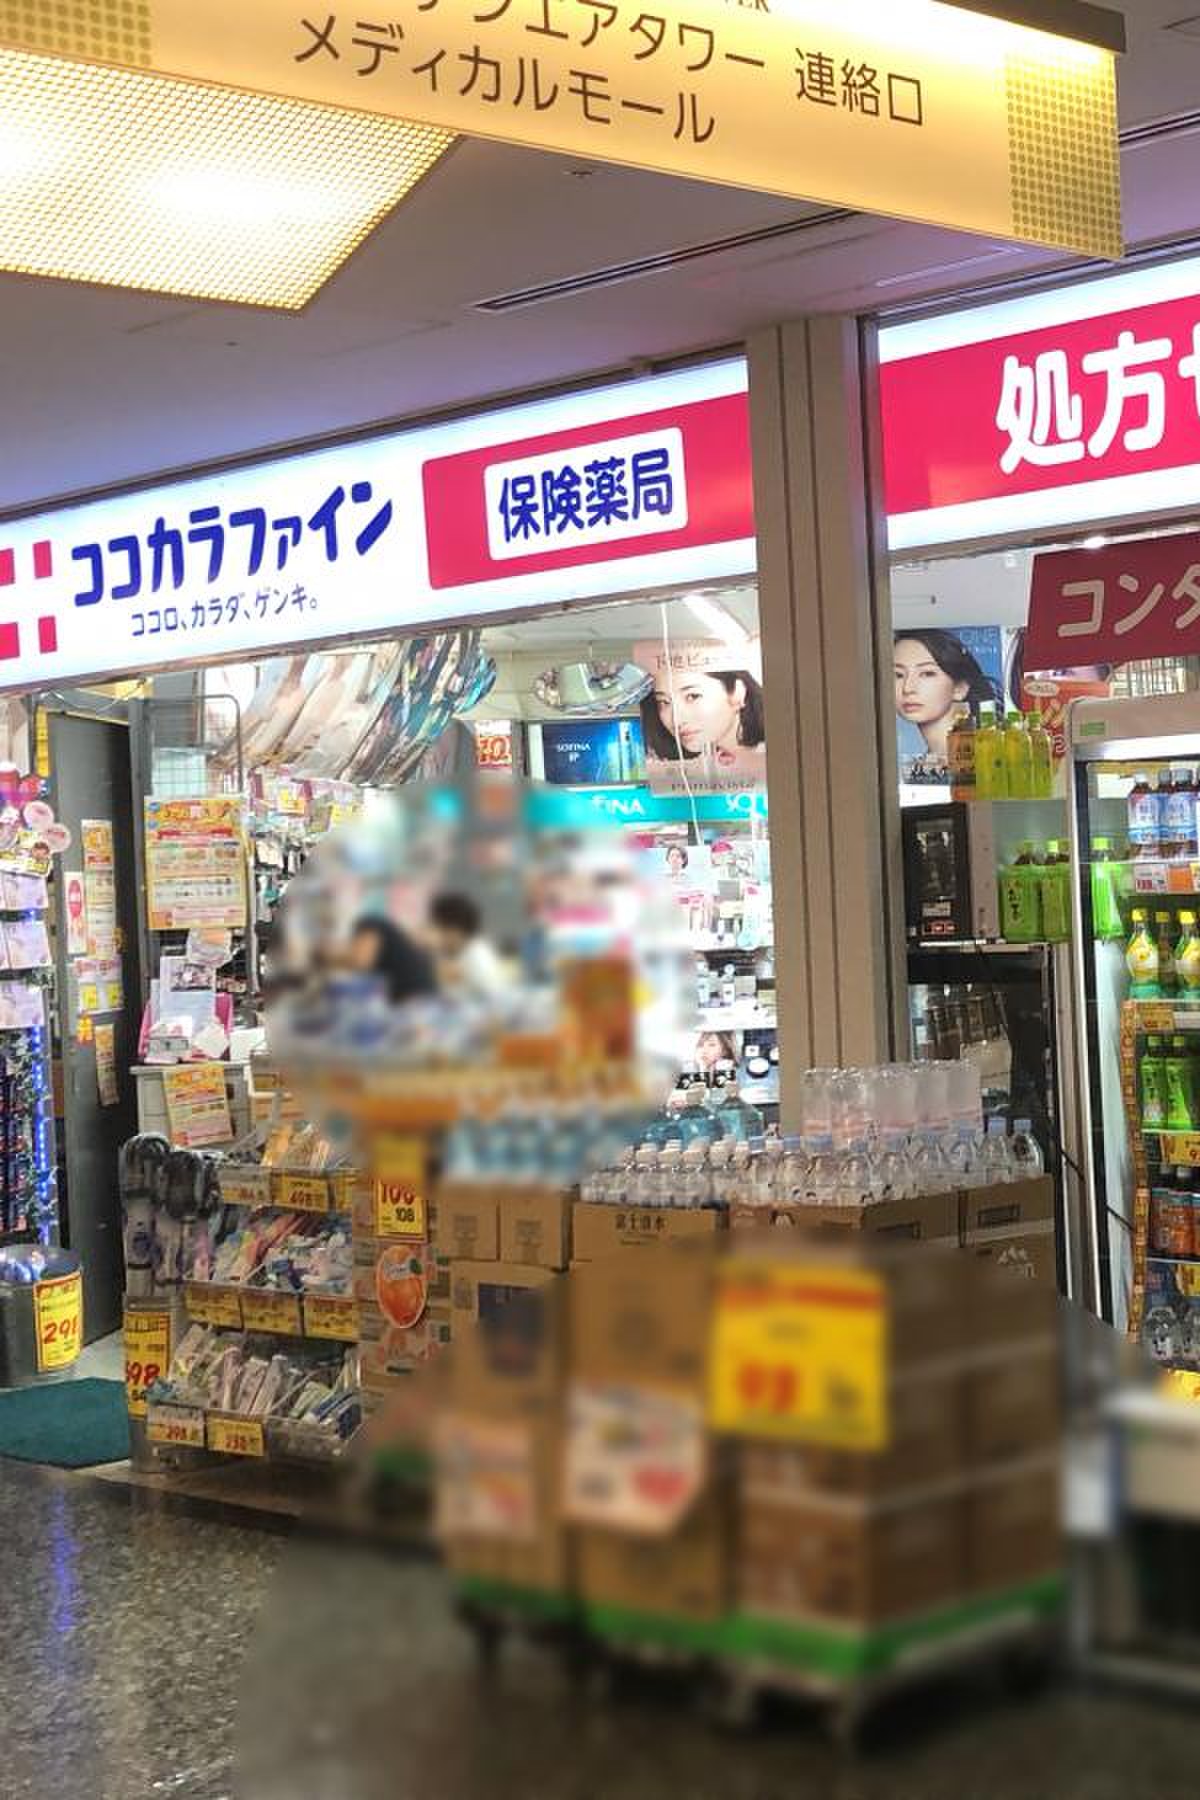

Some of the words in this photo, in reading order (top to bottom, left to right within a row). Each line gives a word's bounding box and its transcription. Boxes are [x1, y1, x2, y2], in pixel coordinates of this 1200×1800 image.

[294, 15, 715, 143] メディカルモール
[418, 0, 765, 71] エアタワー
[795, 48, 922, 126] 連絡口
[71, 481, 393, 607] ココカラファイン
[498, 447, 675, 542] 保険薬局
[131, 582, 318, 636] ココロ、カラダ、ゲンキ。
